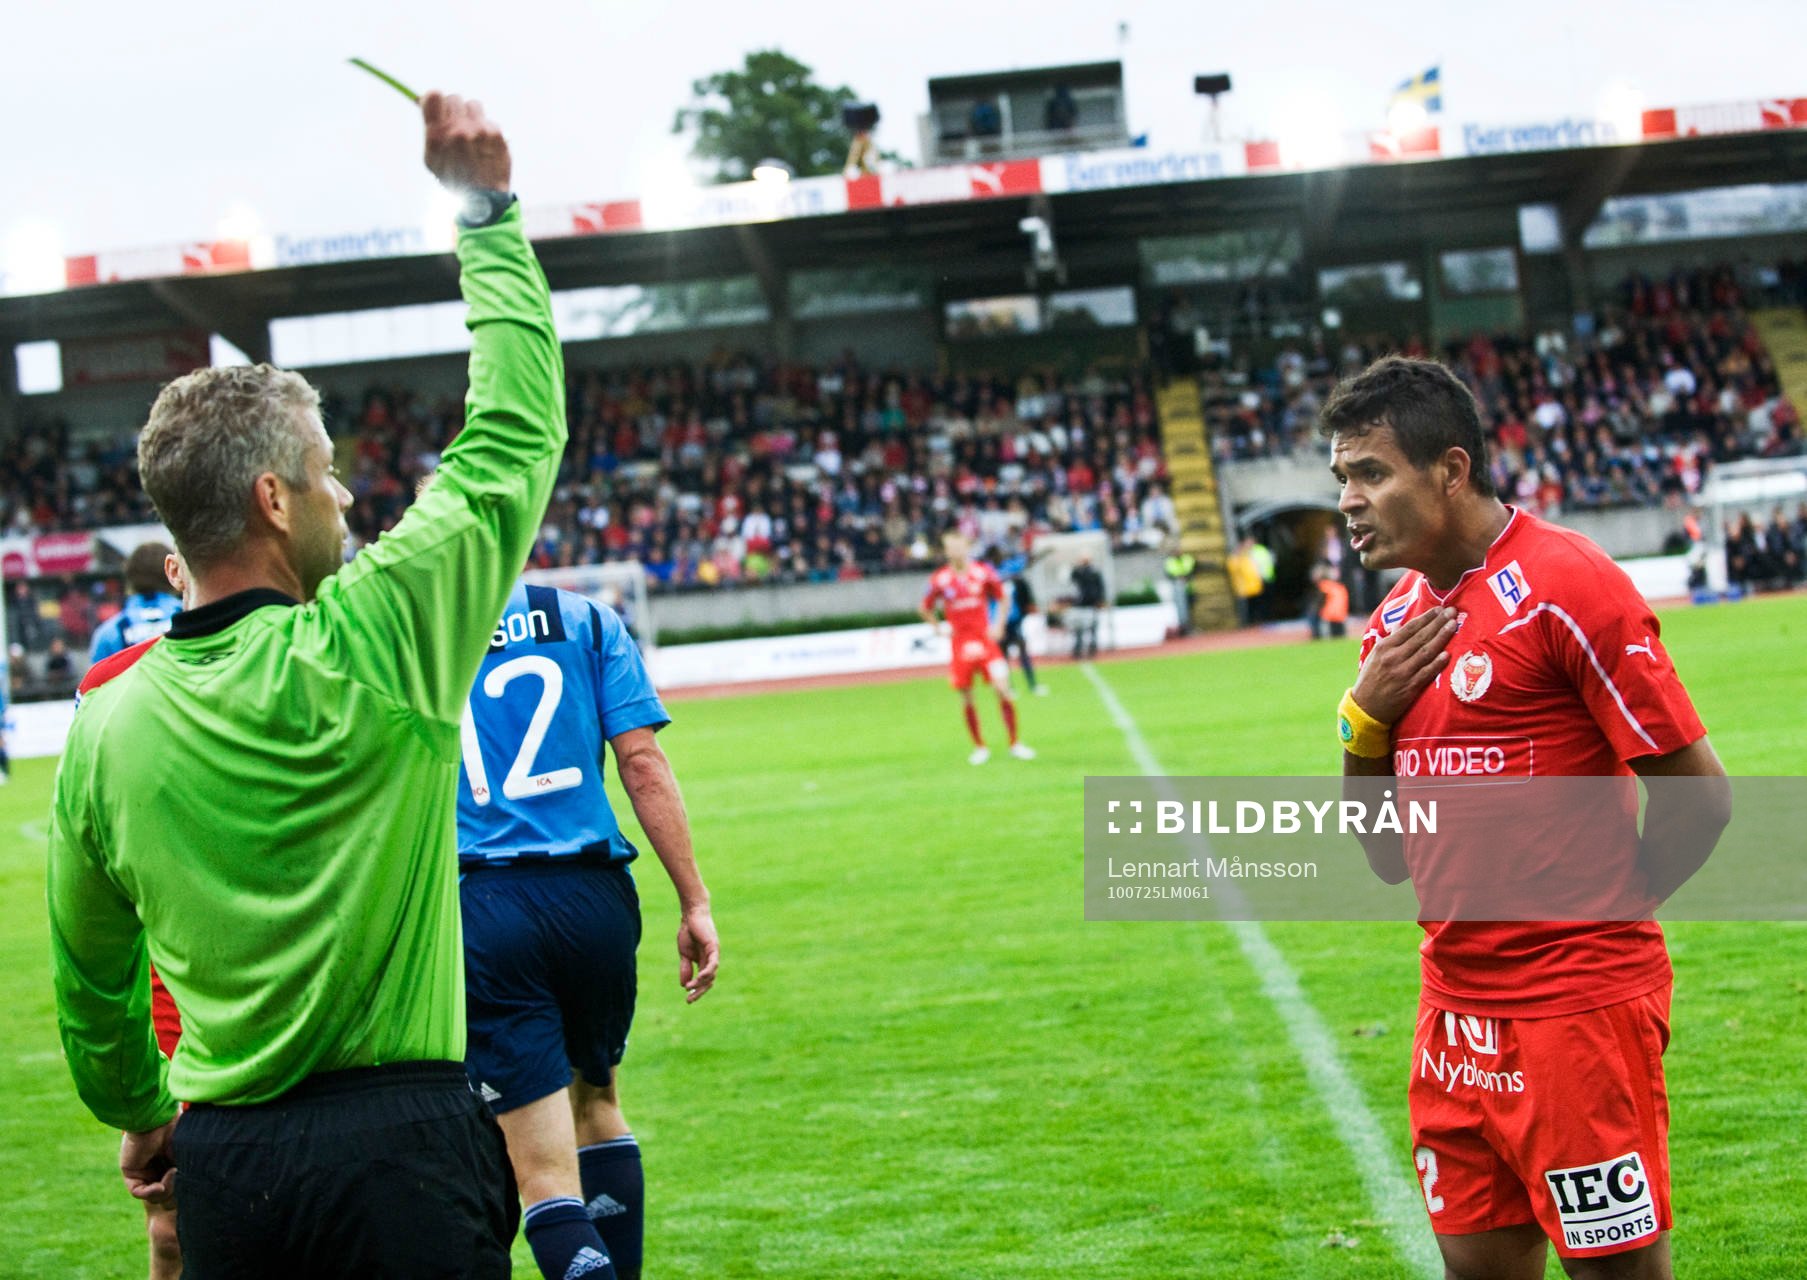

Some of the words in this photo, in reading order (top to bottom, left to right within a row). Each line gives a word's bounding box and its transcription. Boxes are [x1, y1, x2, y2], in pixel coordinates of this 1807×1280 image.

[1425, 746, 1505, 776] VIDEO
[1421, 1048, 1524, 1093] Nybloms
[1549, 1157, 1645, 1214] IEC
[1566, 1229, 1583, 1247] IN
[1585, 1214, 1654, 1245] SPORTS
